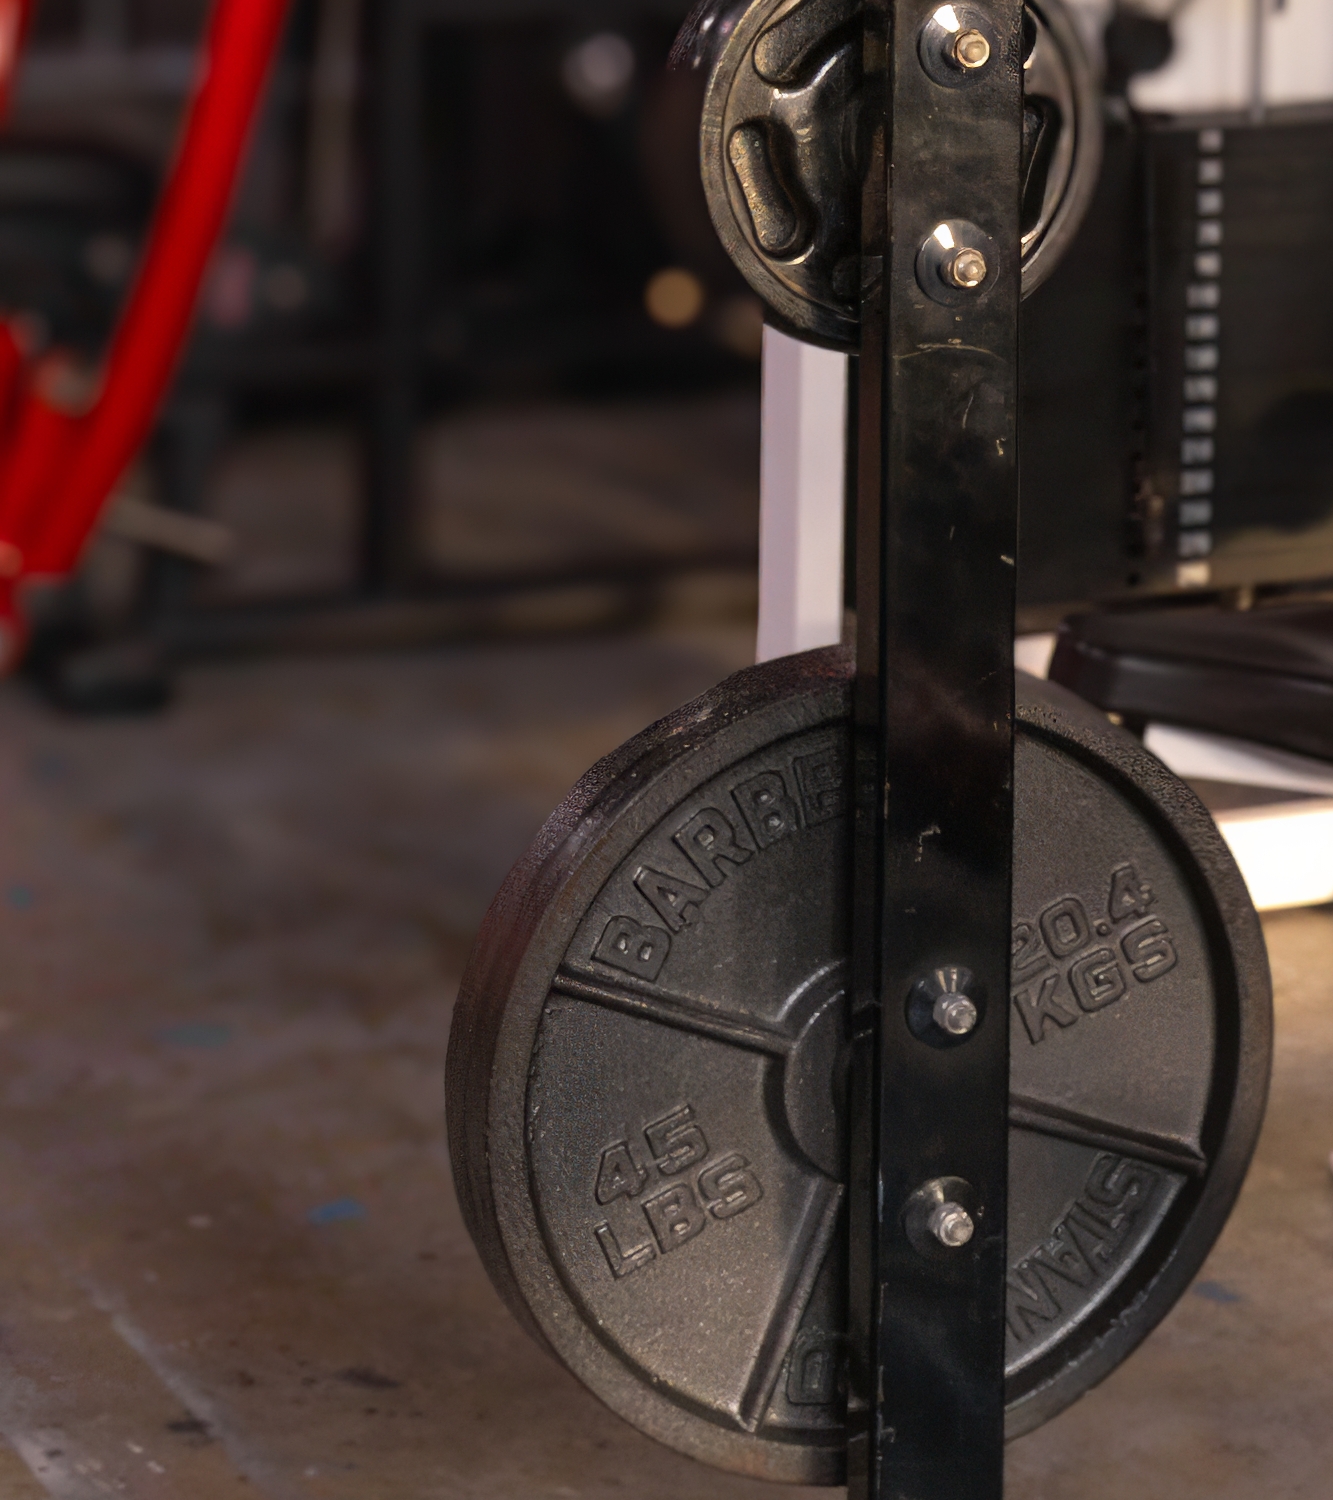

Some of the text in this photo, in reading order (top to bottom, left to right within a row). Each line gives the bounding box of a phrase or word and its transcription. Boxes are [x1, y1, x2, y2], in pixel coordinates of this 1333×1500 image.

[591, 750, 846, 982] BARBE
[1012, 862, 1156, 985] 20.4
[1013, 914, 1178, 1045] KGS
[594, 1153, 764, 1278] LBS
[595, 1104, 710, 1205] 45
